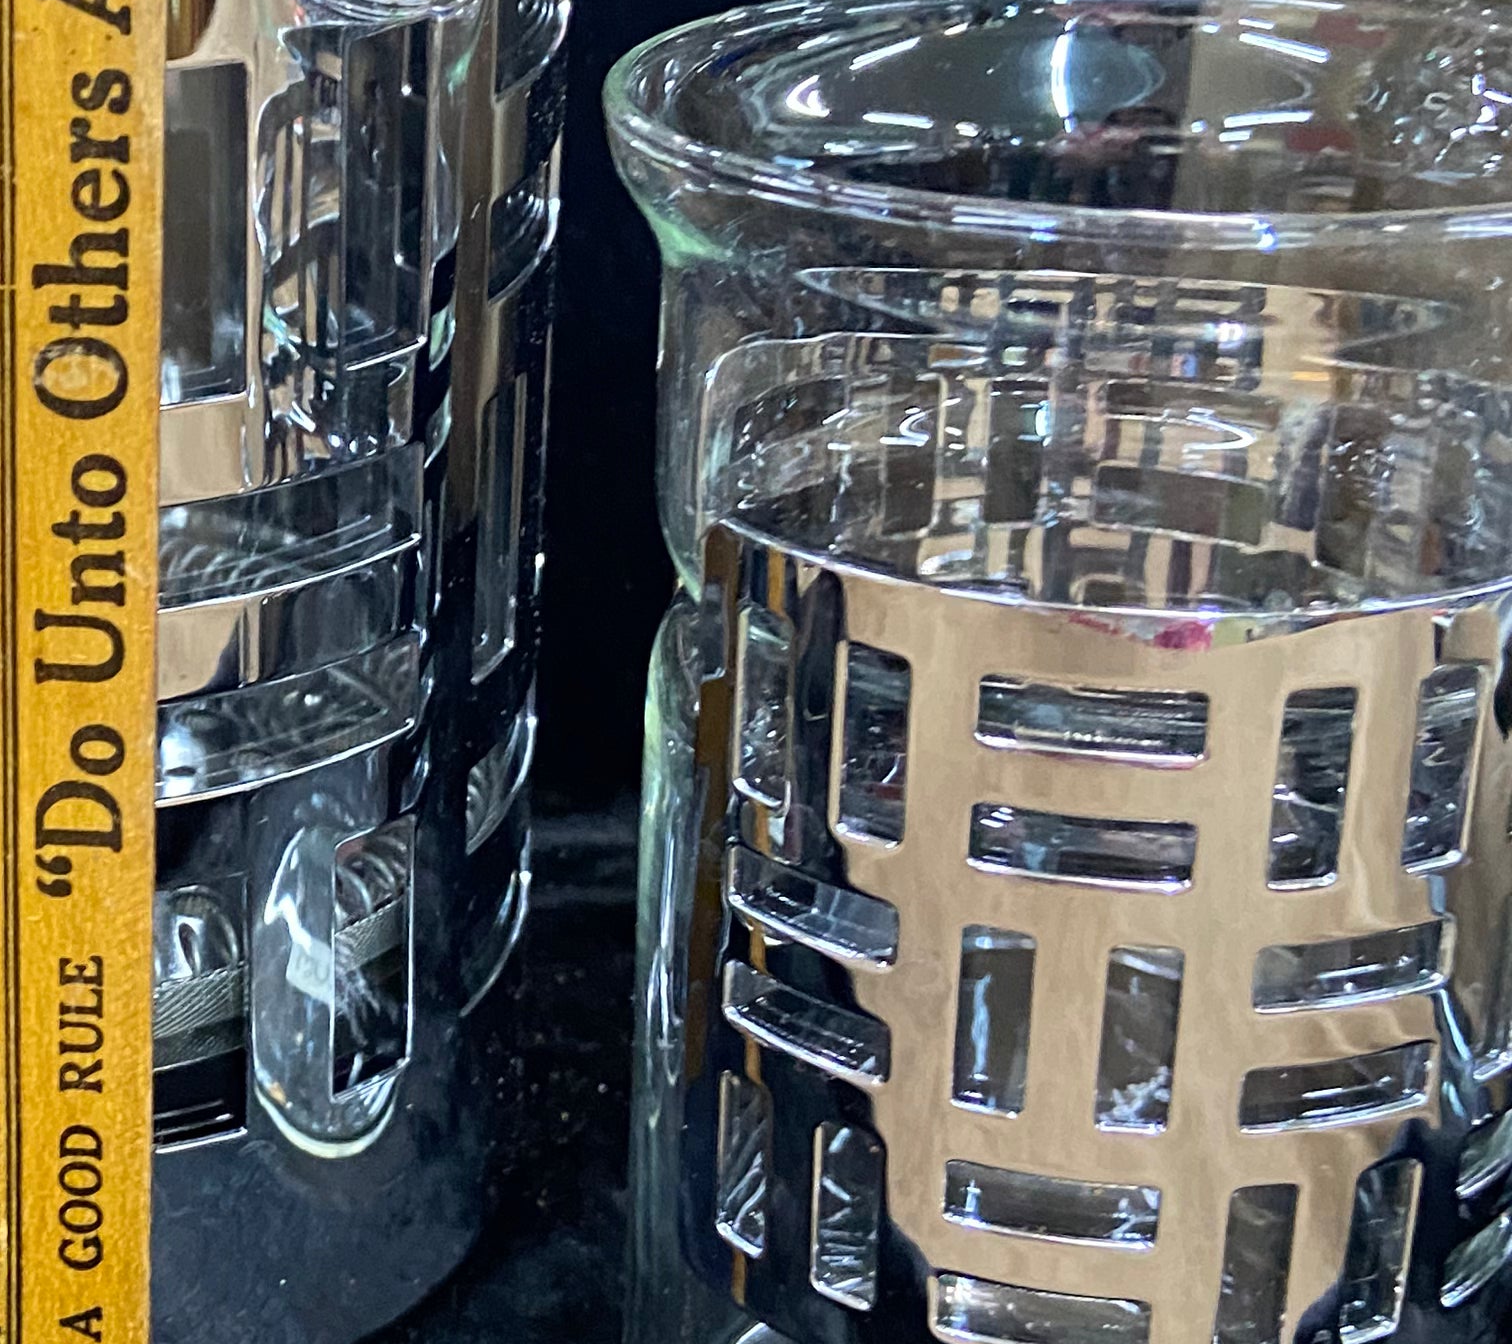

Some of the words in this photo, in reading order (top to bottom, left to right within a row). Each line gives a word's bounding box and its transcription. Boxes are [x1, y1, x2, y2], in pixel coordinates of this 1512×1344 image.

[31, 68, 131, 420] Others
[34, 453, 128, 685] Unto
[58, 954, 105, 1094] RULE
[58, 1123, 104, 1272] GOOD
[59, 1305, 103, 1343] A
